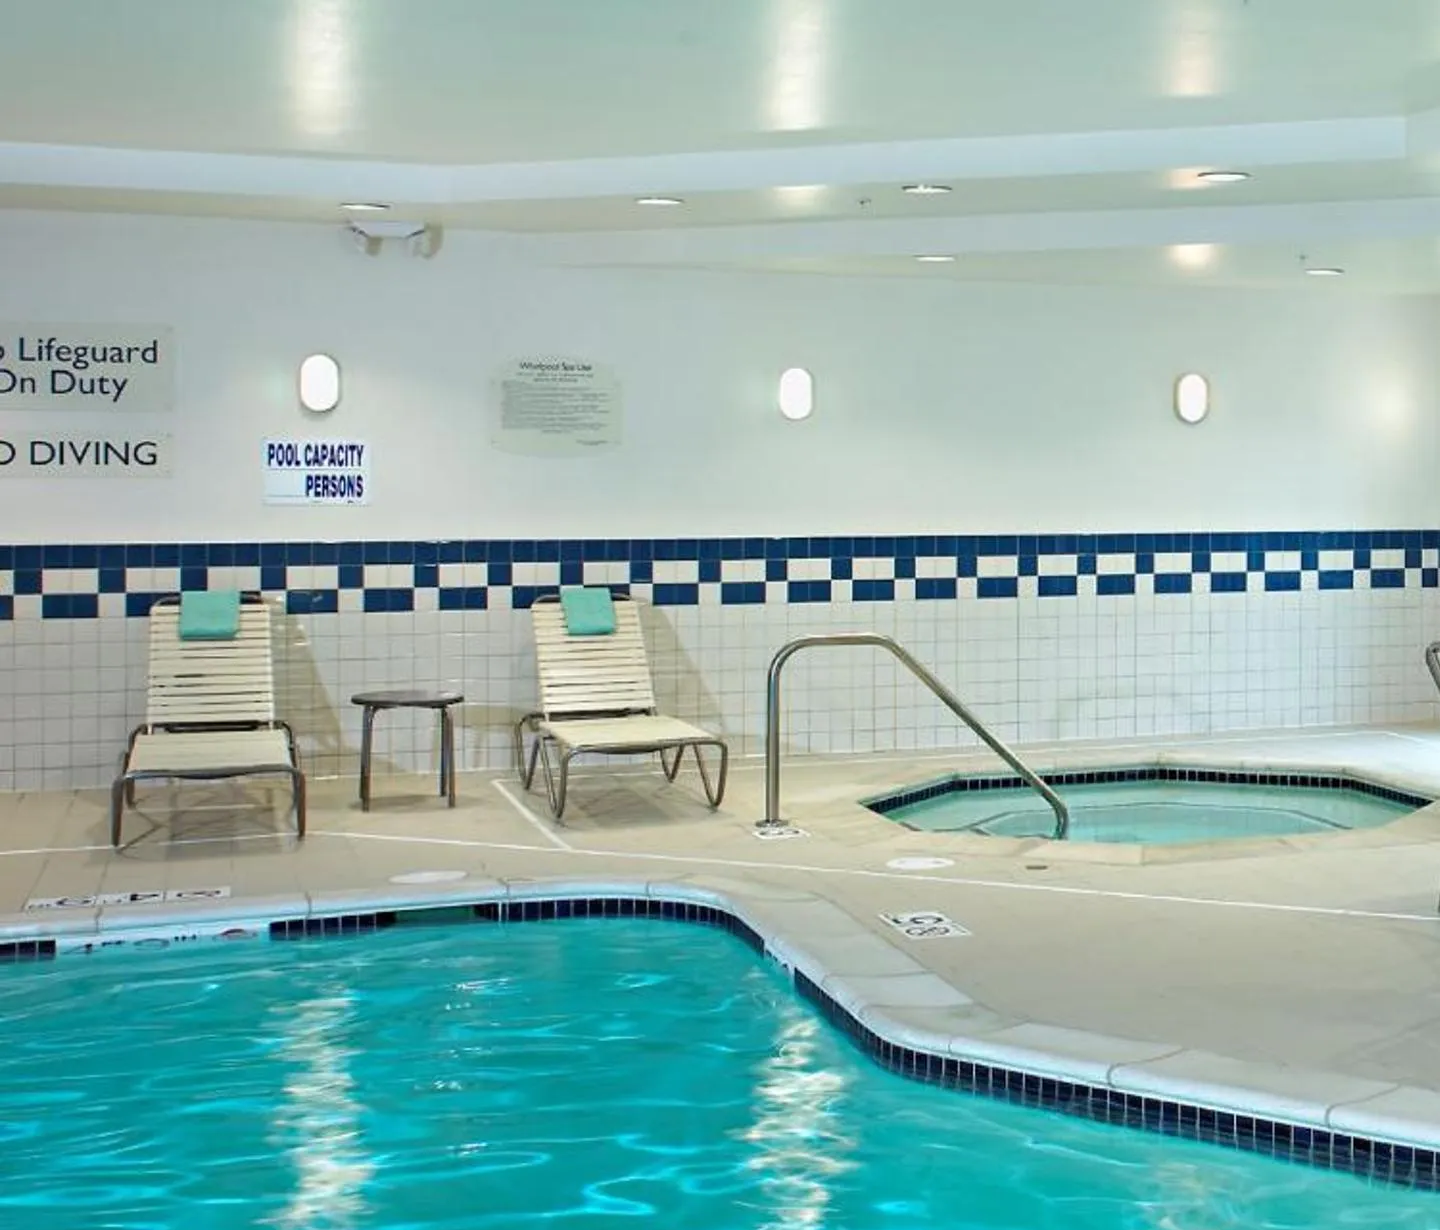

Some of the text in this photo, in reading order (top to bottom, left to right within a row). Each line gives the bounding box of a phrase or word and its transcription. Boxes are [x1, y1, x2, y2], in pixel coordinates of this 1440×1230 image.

[18, 337, 158, 369] Lifeguard
[51, 370, 128, 403] Duty
[30, 441, 158, 466] DIVING
[267, 443, 364, 467] POOL CAPACITY
[305, 474, 364, 498] PERSONS
